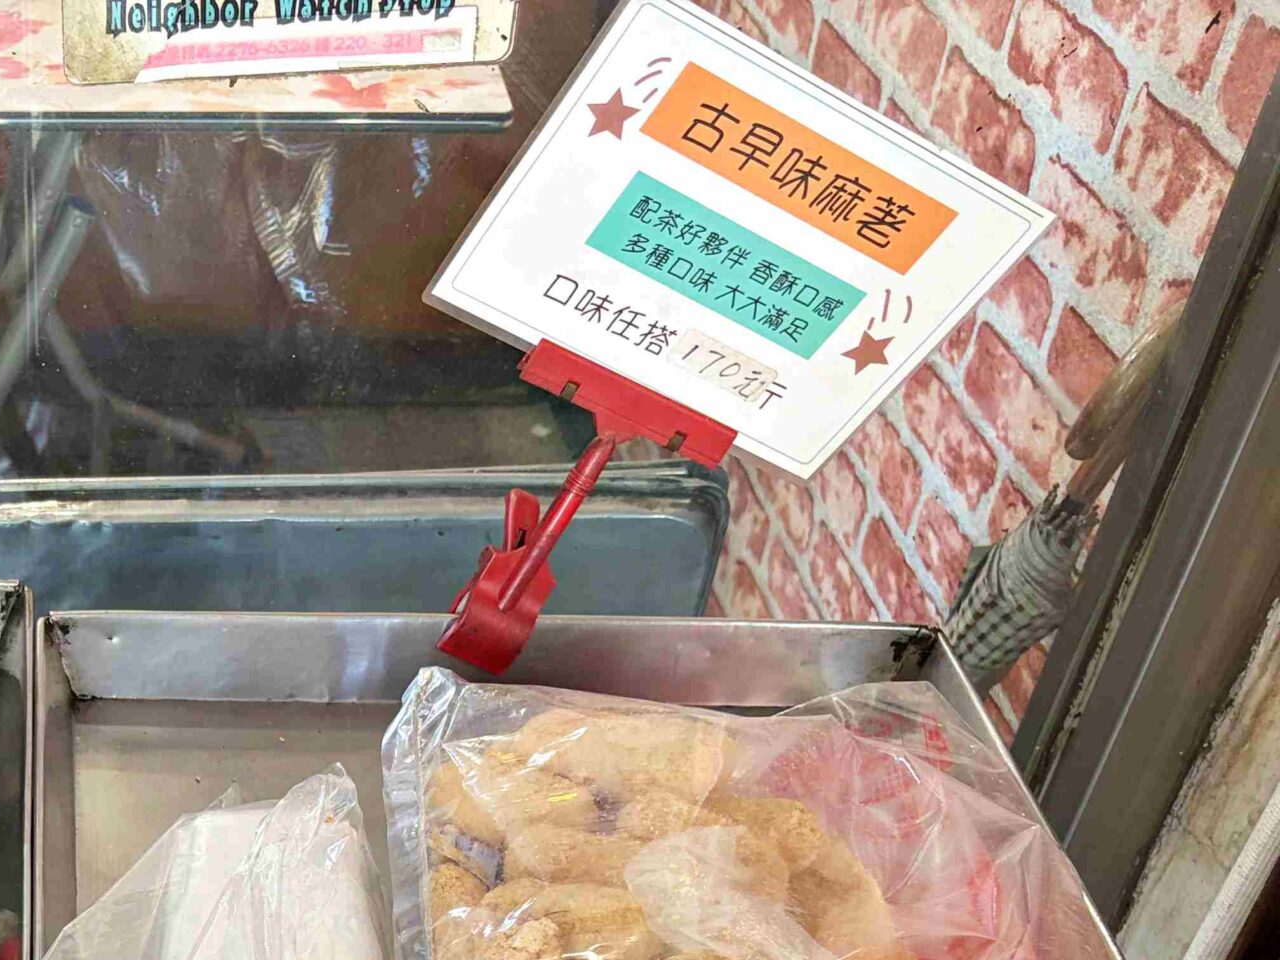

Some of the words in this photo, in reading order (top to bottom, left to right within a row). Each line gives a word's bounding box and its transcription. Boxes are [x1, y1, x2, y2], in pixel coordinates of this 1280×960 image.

[681, 101, 917, 250] 古早味麻荖
[543, 274, 679, 357] 口味任搭
[620, 233, 715, 295] 多種口味
[714, 284, 811, 345] 大大滿足
[629, 194, 751, 270] 配茶好夥伴
[751, 259, 845, 323] 香酥口感
